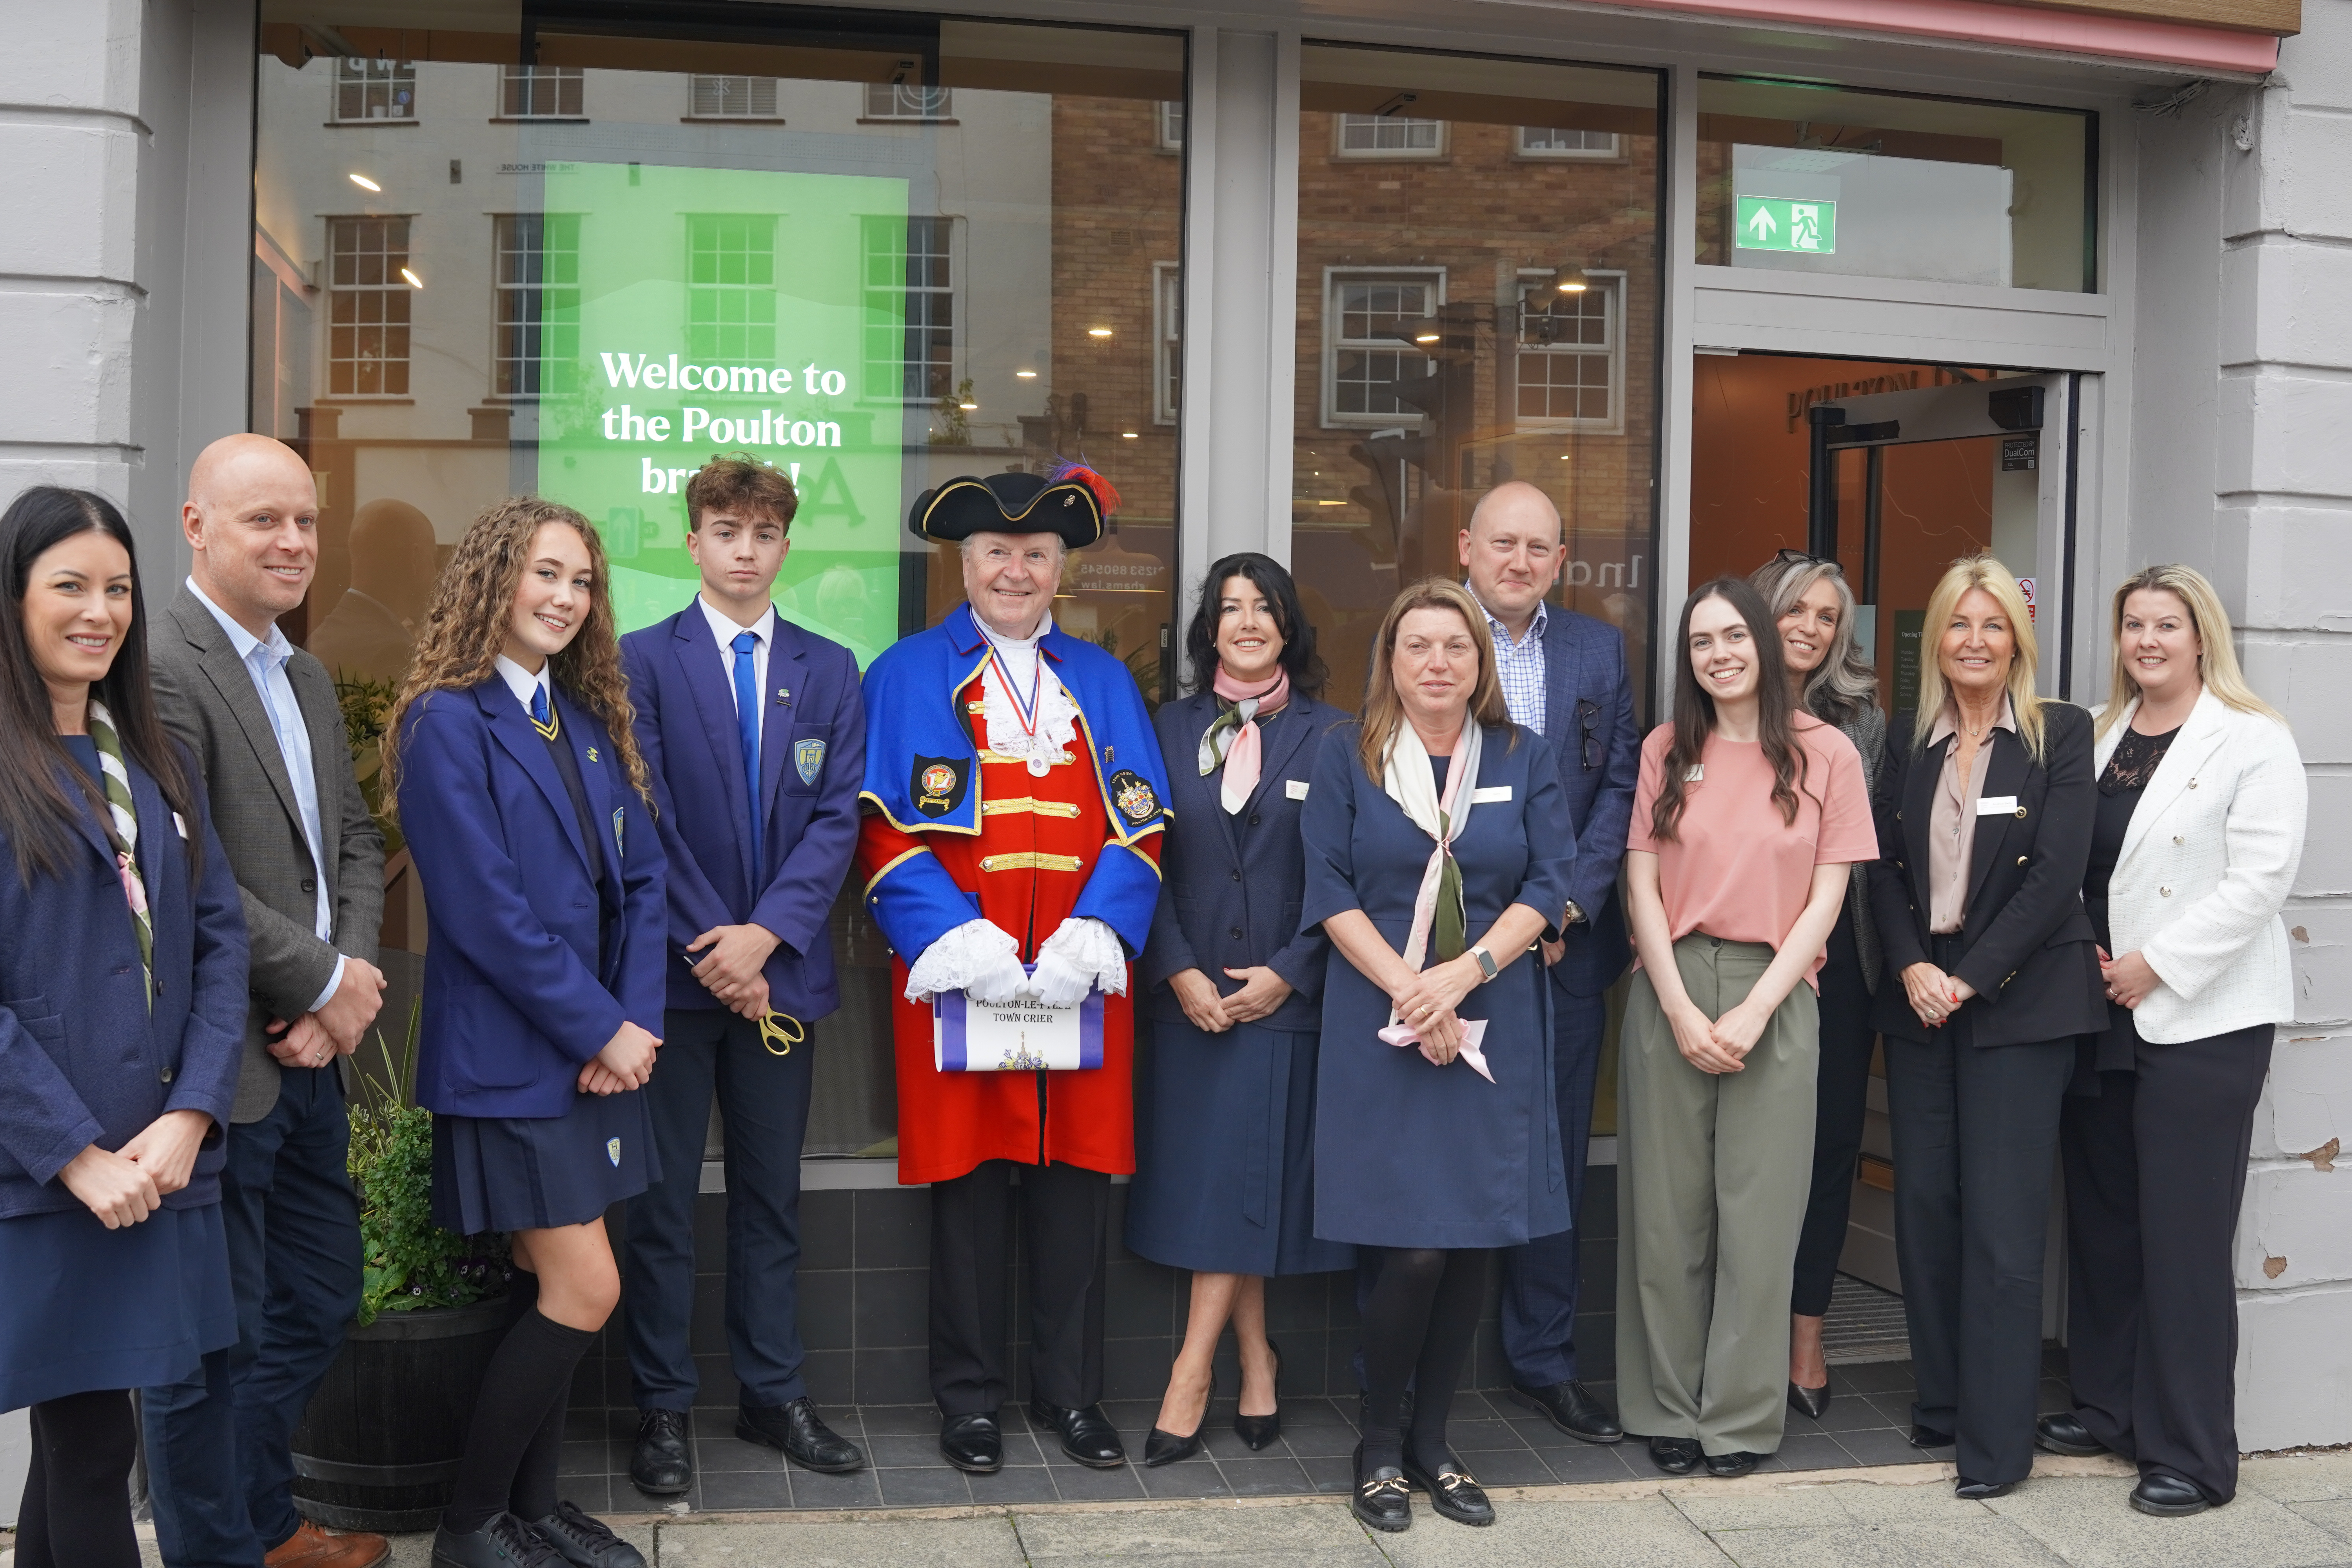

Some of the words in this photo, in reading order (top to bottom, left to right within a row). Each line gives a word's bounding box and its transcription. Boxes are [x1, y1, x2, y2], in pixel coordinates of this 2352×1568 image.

[600, 352, 792, 394] Welcome
[803, 363, 846, 395] to
[602, 405, 670, 441] the
[682, 408, 841, 446] Poulton
[2004, 448, 2034, 457] DualCom
[993, 1012, 1020, 1022] TOWN
[1024, 1014, 1053, 1023] CRIER
